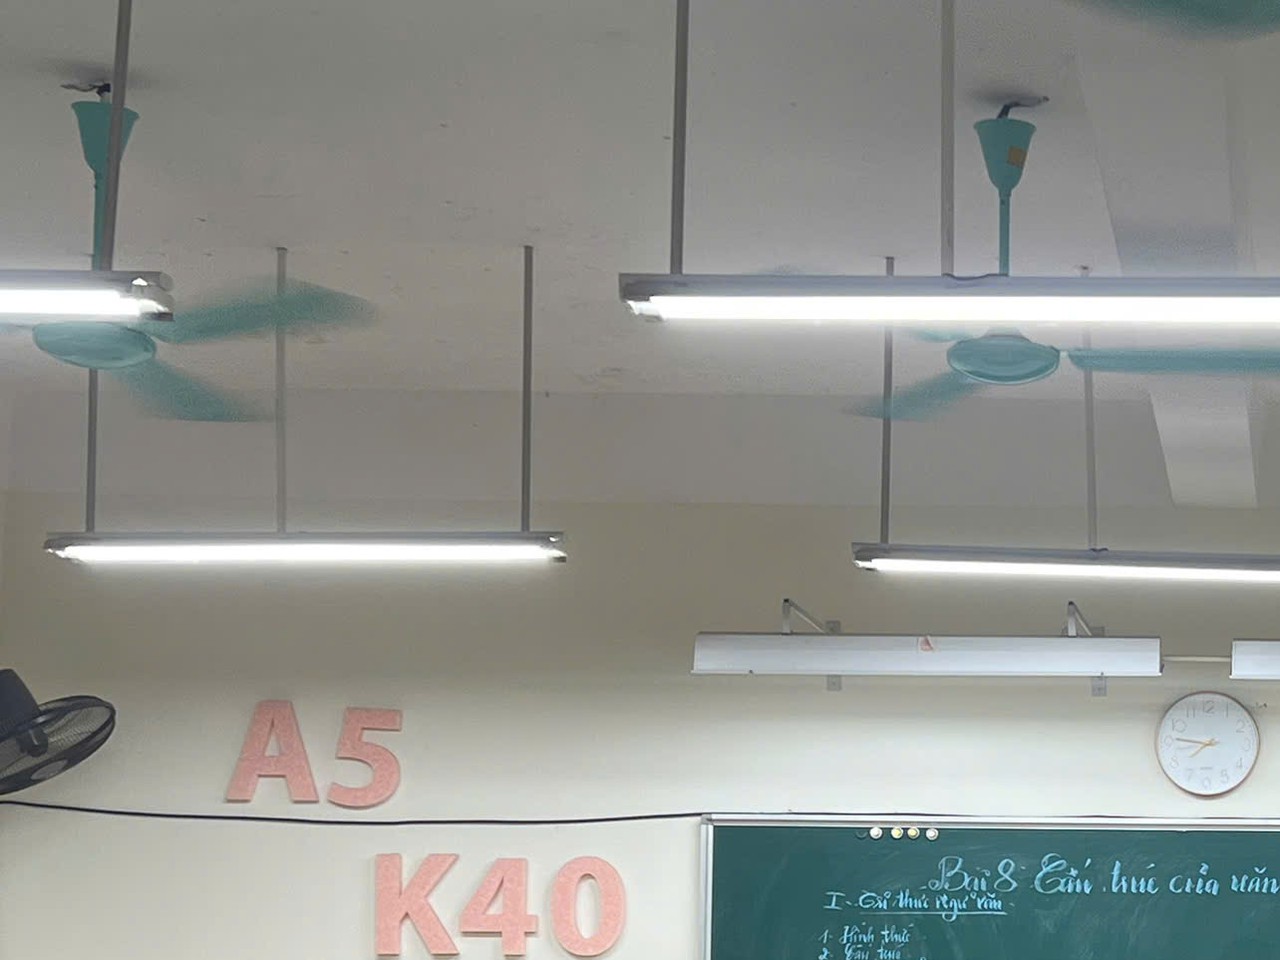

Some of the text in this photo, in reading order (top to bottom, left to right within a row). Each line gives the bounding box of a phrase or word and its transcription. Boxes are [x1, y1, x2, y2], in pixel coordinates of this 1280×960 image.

[224, 699, 404, 809] A5
[374, 853, 628, 959] K40
[1168, 863, 1220, 896] của
[1231, 866, 1280, 895] văn
